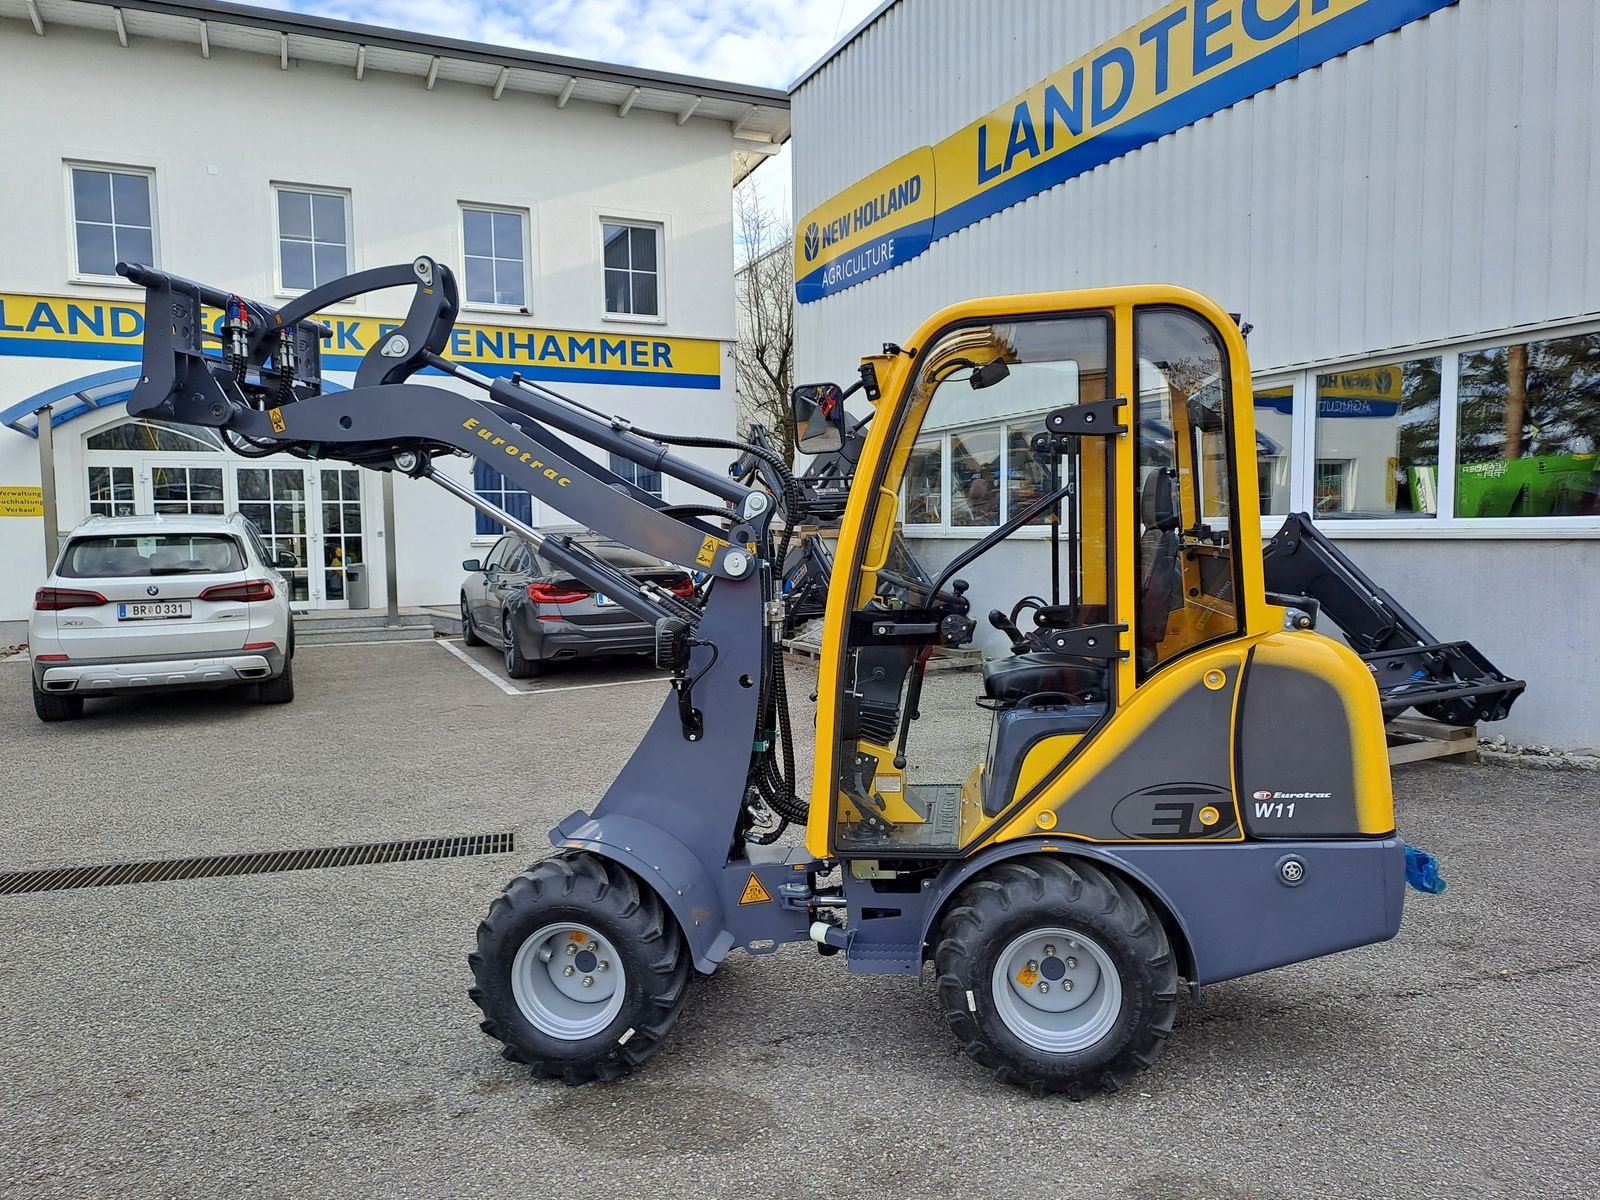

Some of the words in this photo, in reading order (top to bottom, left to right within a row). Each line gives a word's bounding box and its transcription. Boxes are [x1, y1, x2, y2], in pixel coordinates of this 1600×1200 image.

[977, 0, 1330, 186] LANDTEC
[822, 213, 851, 249] NEW
[853, 174, 921, 233] HOLLAND
[821, 239, 895, 288] AGRICULTURE
[462, 417, 572, 487] Eurotrac
[1255, 802, 1295, 818] W11
[1273, 791, 1332, 799] Eurotrac
